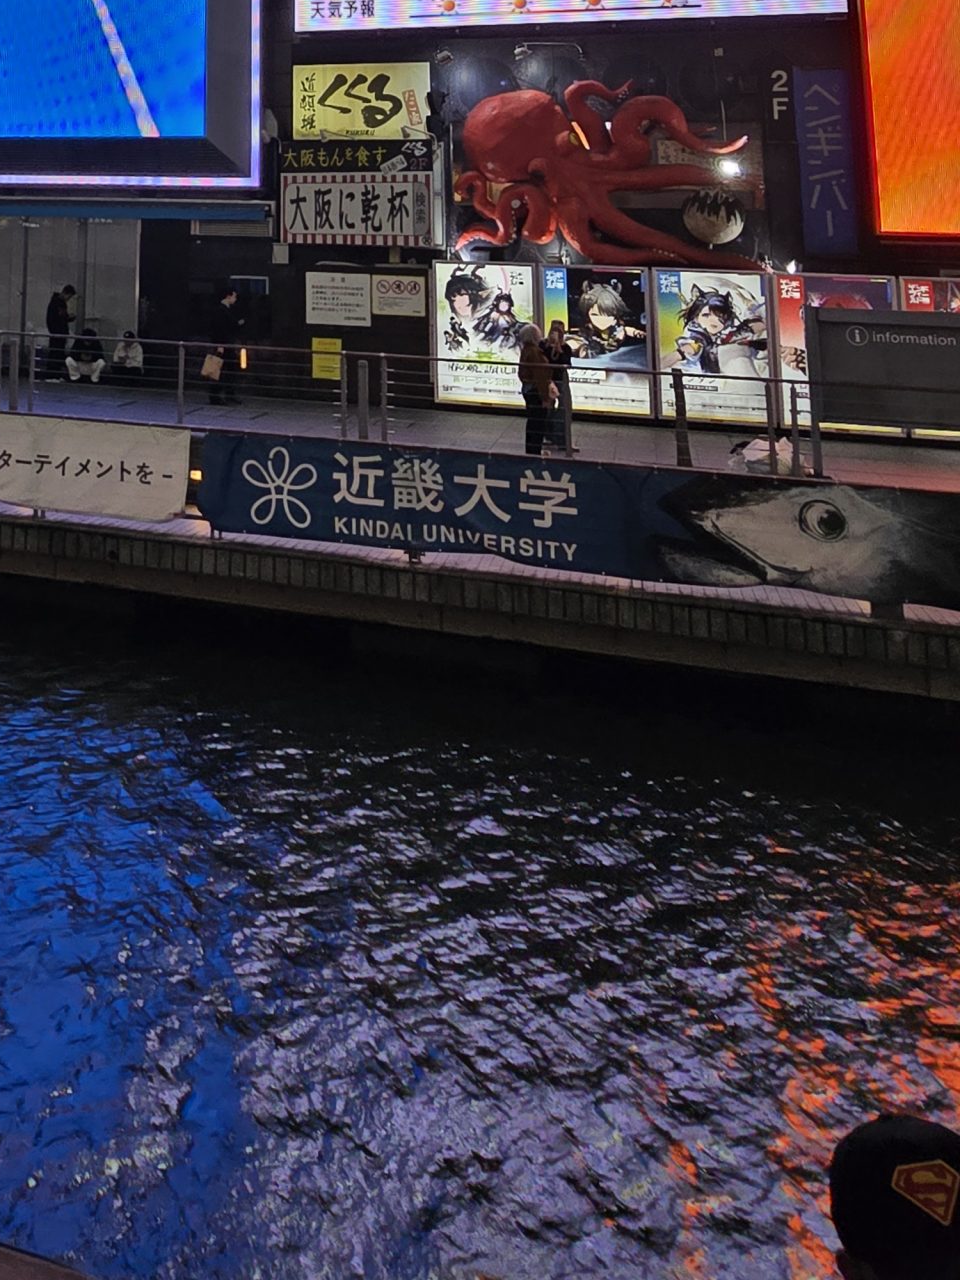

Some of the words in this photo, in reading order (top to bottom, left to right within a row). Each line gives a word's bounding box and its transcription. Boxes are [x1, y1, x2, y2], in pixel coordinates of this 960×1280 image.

[310, 0, 376, 19] 天気予報
[317, 73, 403, 129] くくる
[770, 70, 789, 120] 2F
[283, 145, 387, 168] 大阪もんを食す
[289, 184, 410, 234] 大阪に乾杯
[872, 331, 957, 346] information
[331, 452, 579, 529] 近畿大学
[333, 516, 414, 542] KINDAI
[422, 523, 578, 562] UNIVERSITY
